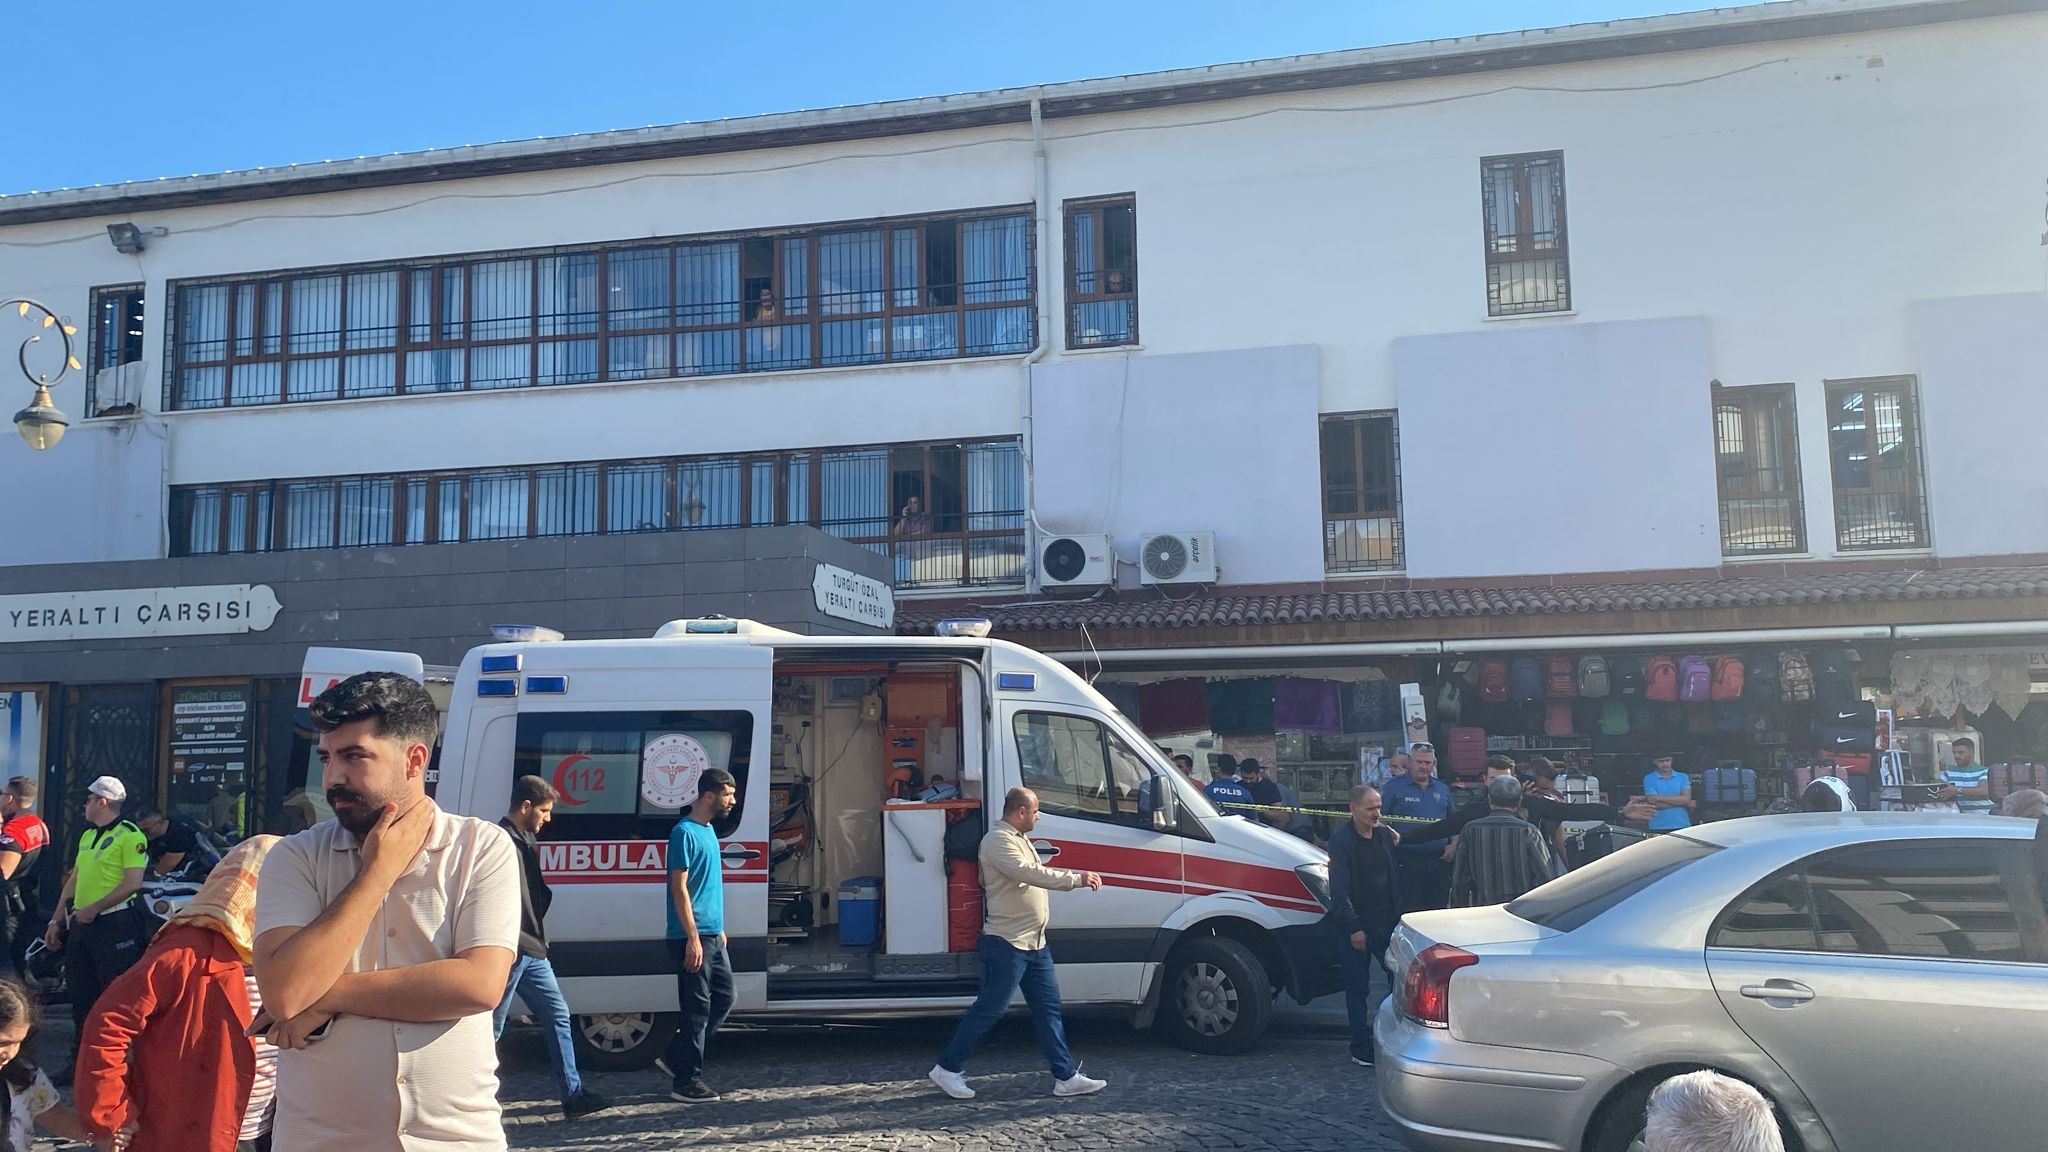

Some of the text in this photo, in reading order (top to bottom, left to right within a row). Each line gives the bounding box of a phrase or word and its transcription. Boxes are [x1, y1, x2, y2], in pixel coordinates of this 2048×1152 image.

[1190, 536, 1200, 563] arçelik
[10, 600, 250, 628] YERALTI ÇARŞISI
[825, 591, 856, 611] YERALTI
[568, 768, 605, 791] 112
[540, 844, 668, 871] MBULA
